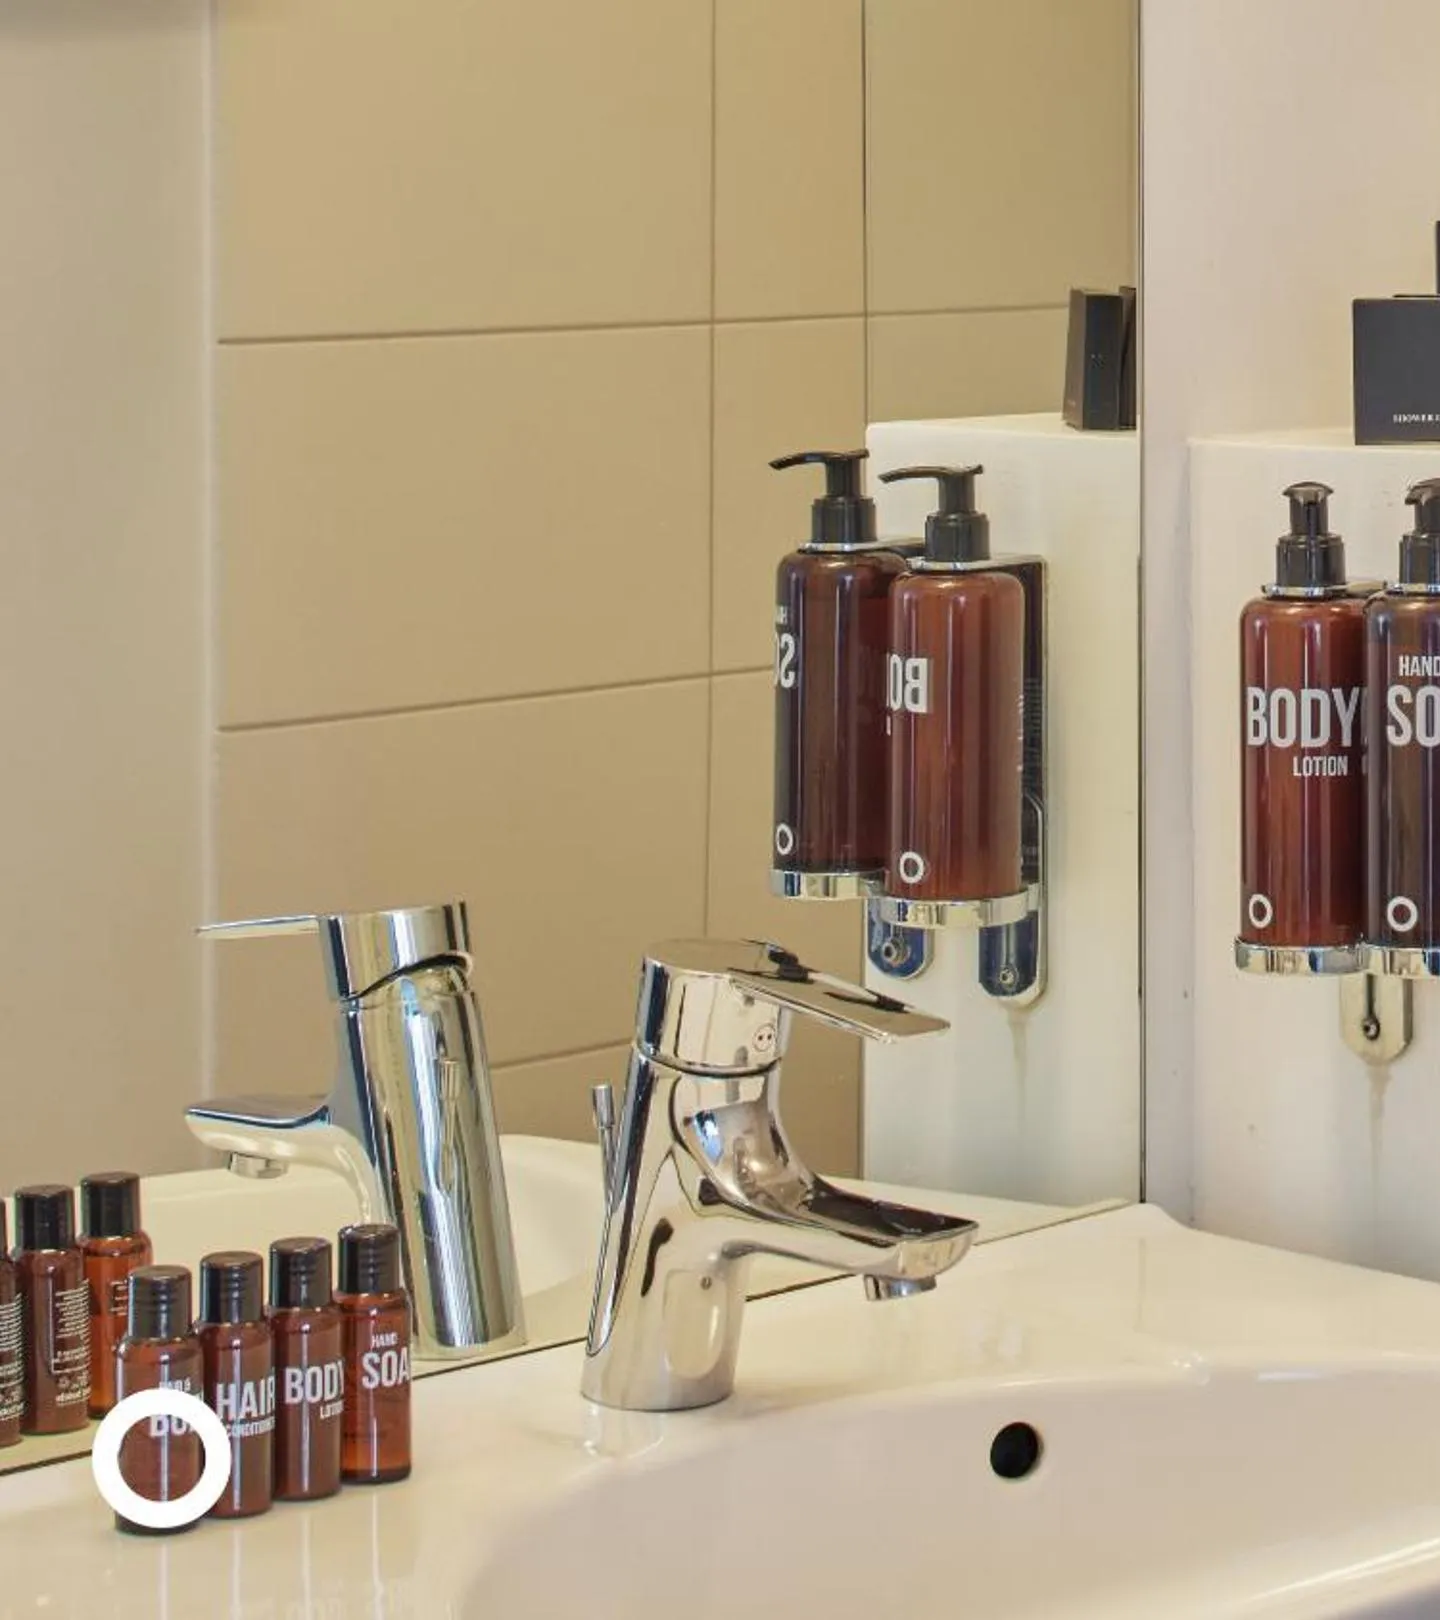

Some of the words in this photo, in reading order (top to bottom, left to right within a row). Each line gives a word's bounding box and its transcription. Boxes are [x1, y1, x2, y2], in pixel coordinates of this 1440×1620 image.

[1247, 686, 1360, 748] BODY
[1293, 756, 1348, 776] LOTION
[371, 1332, 398, 1348] HAND
[217, 1376, 276, 1421] HAIR
